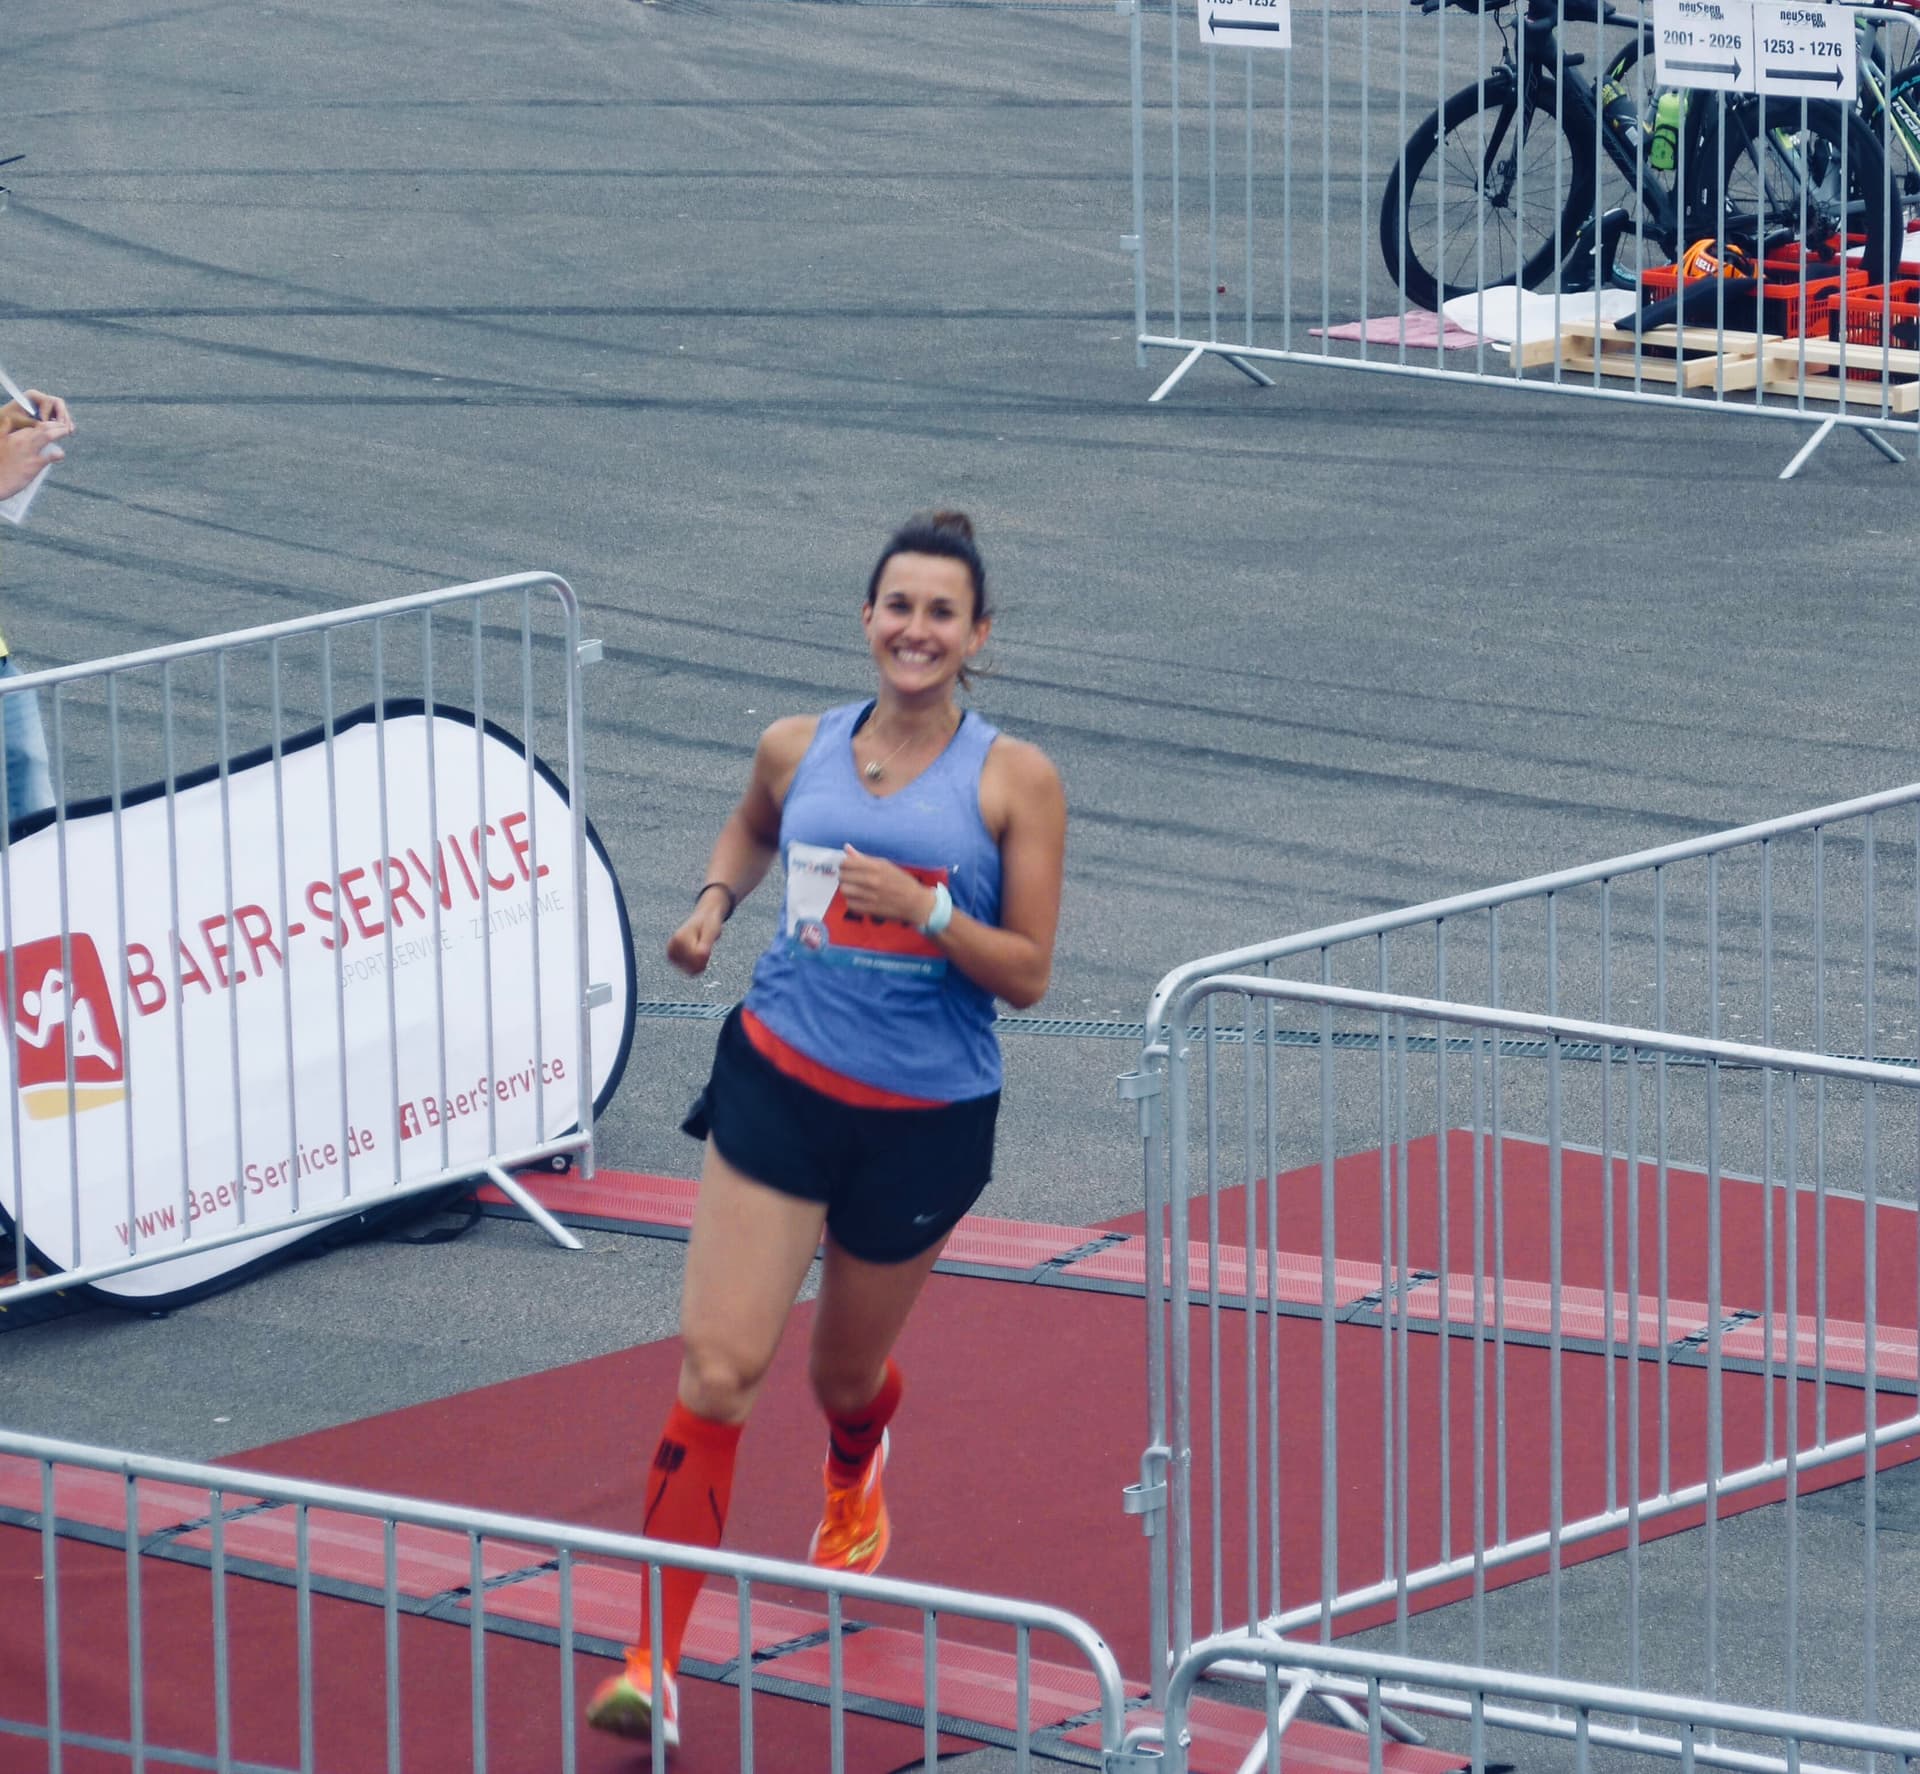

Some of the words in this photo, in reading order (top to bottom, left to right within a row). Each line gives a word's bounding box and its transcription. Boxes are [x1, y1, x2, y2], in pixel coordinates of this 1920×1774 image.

[1664, 30, 1694, 46] 2001
[1709, 33, 1742, 49] 2026
[1763, 38, 1795, 55] 1253
[1809, 41, 1842, 57] 1276
[126, 811, 550, 1017] BAER-SERVICE
[338, 928, 453, 990] PORTERVIE
[468, 890, 566, 940] ZITNAME
[421, 1057, 566, 1128] BaerService
[114, 1125, 375, 1246] www.BaerSericede
